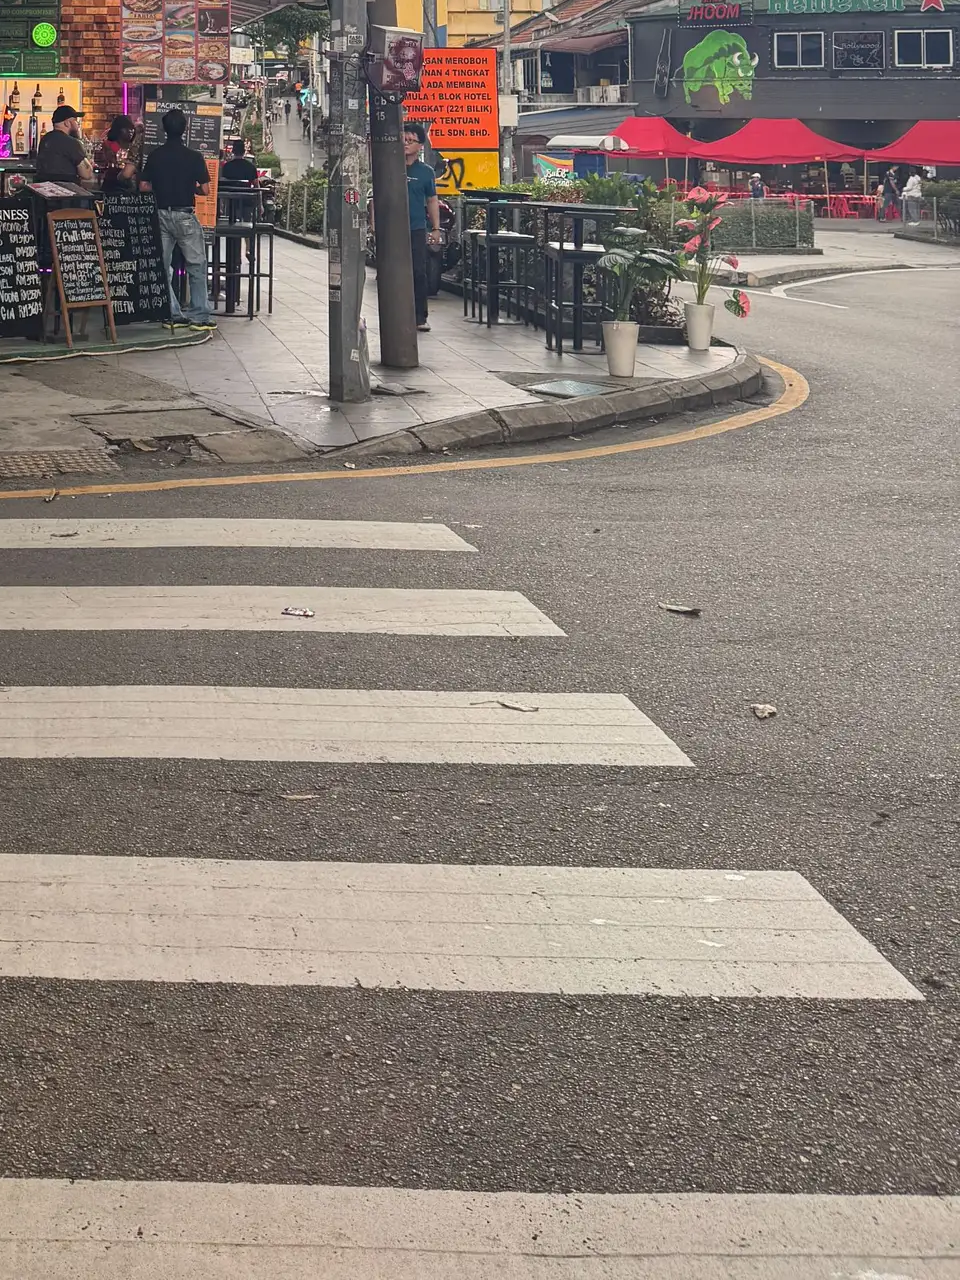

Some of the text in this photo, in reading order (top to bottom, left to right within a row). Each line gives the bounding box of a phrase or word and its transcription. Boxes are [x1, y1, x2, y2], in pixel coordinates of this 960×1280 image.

[687, 3, 740, 20] JHOOM
[841, 42, 882, 55] Bollywood
[425, 57, 488, 65] GAN MEROBOH
[464, 93, 492, 101] HOTEL
[157, 102, 182, 110] PACIFIC
[446, 105, 464, 114] (221
[466, 105, 493, 114] BILIK)
[376, 111, 386, 121] 15
[55, 230, 62, 242] 2
